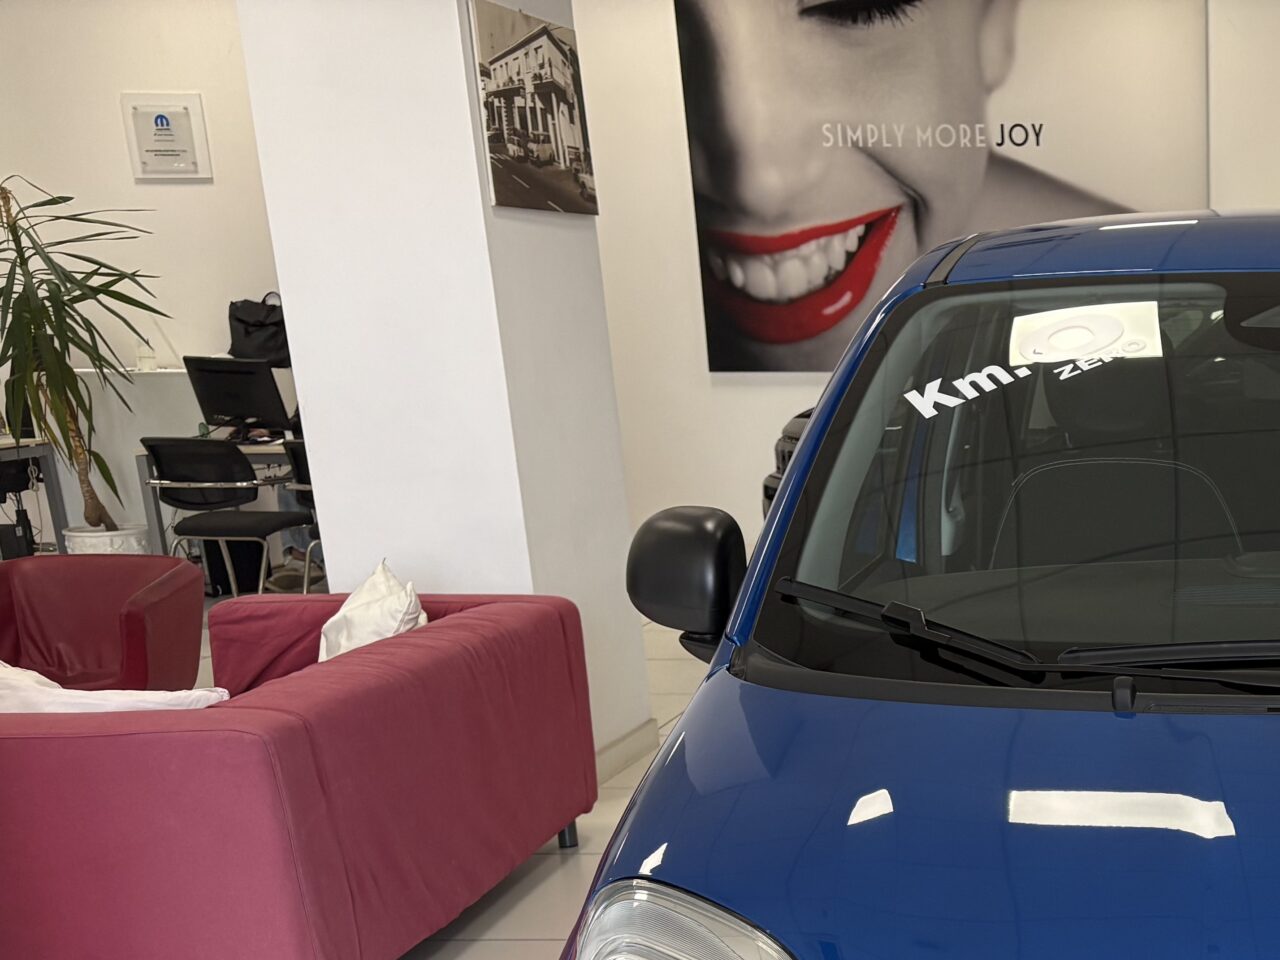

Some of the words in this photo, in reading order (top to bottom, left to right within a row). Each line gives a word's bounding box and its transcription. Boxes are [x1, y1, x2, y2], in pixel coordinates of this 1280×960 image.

[821, 123, 905, 148] SIMPLY
[916, 123, 987, 148] MORE
[995, 123, 1044, 147] JOY
